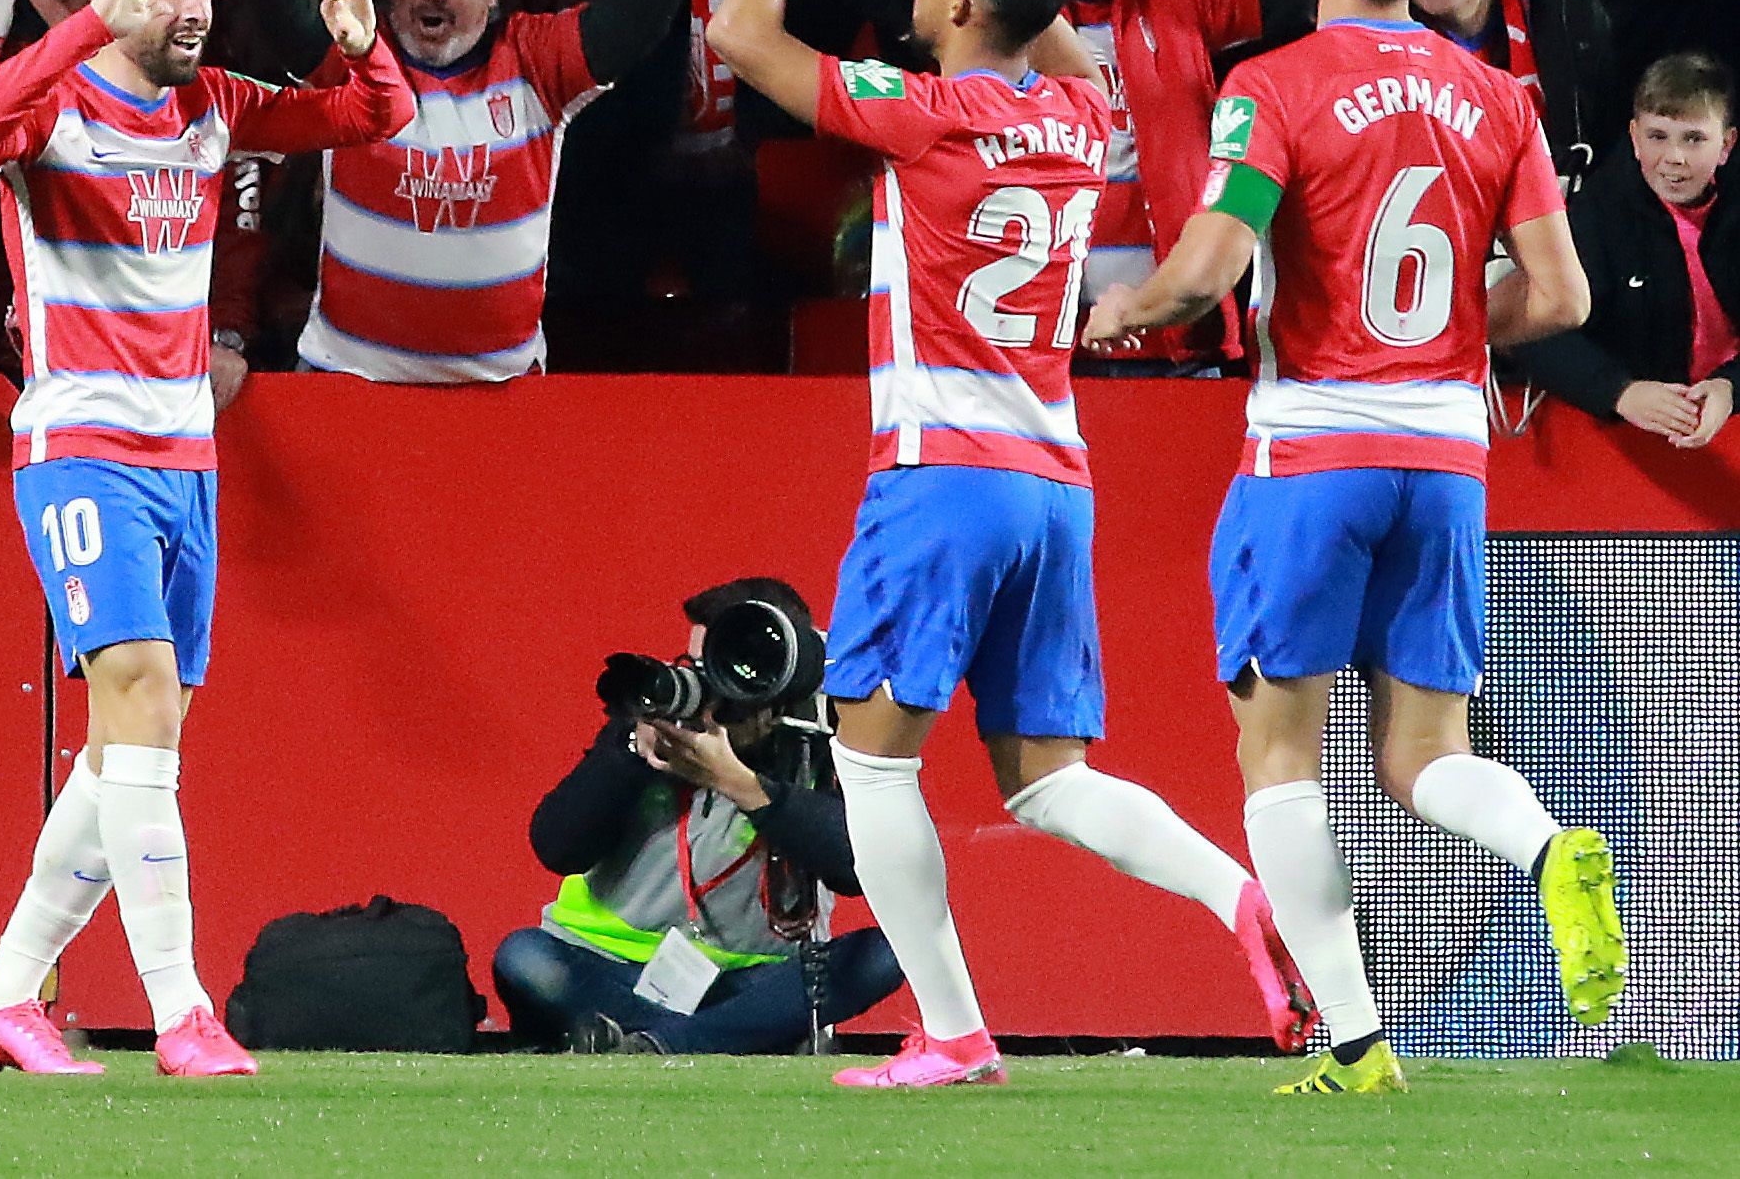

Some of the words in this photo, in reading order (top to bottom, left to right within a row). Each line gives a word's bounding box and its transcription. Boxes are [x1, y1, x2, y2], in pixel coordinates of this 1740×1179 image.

[1333, 74, 1484, 141] GERMÁN
[974, 117, 1105, 176] HERRERA
[139, 199, 194, 219] WINAMAX
[411, 178, 492, 199] WINAMAX
[956, 187, 1101, 349] 21
[1360, 165, 1455, 348] 6
[41, 496, 103, 573] 10
